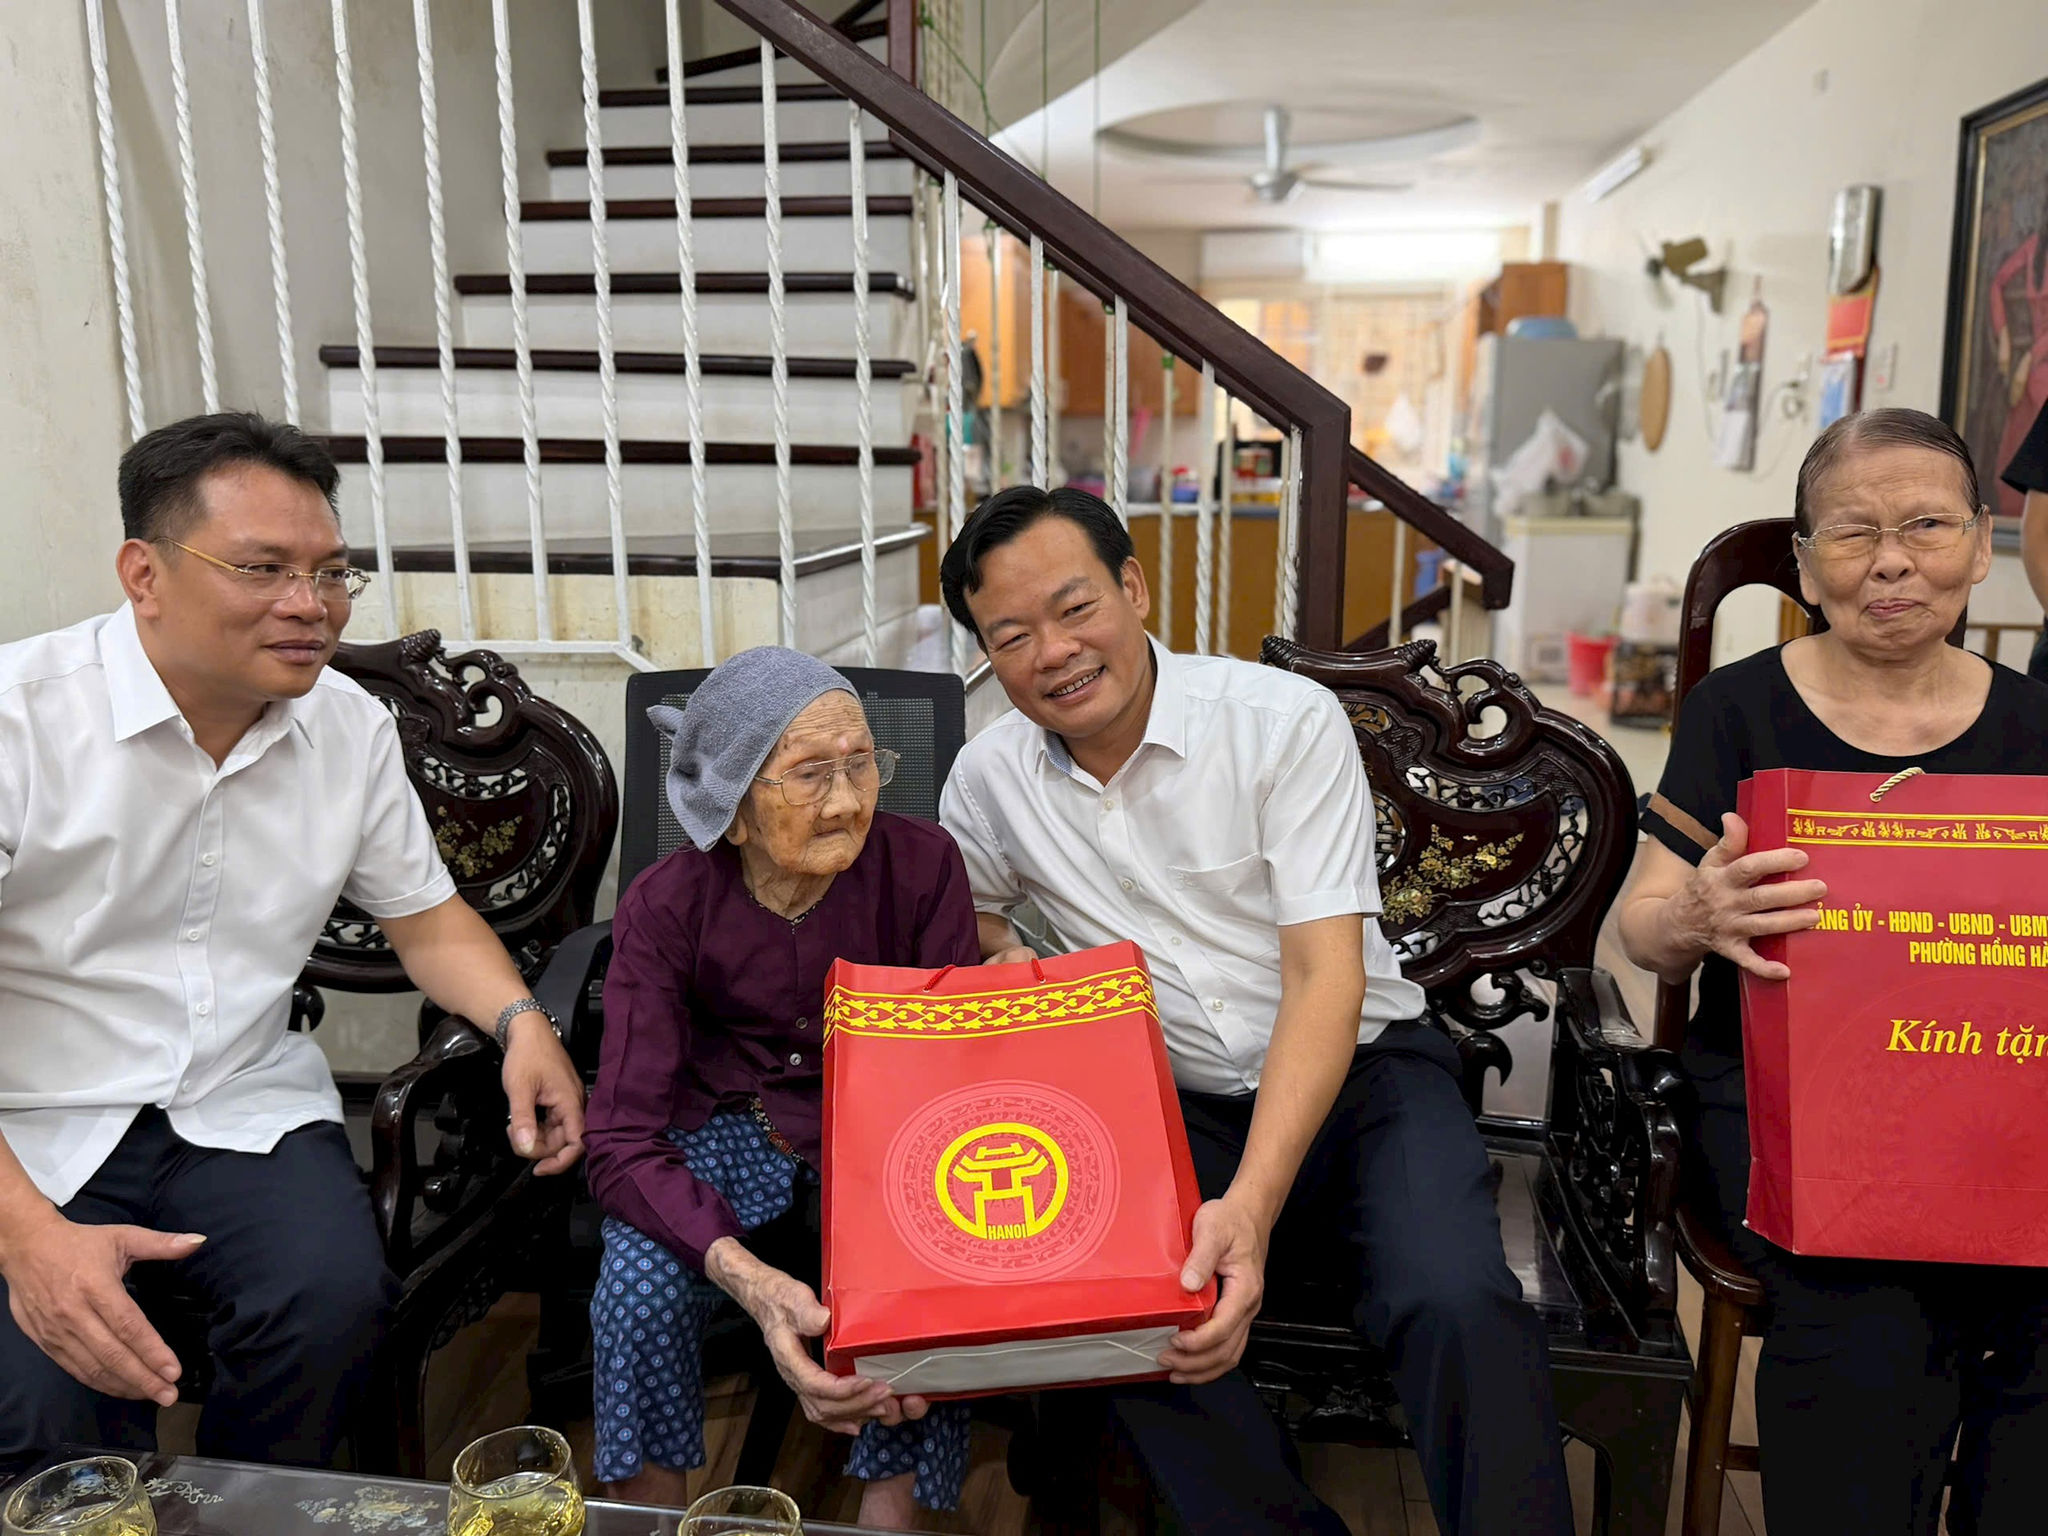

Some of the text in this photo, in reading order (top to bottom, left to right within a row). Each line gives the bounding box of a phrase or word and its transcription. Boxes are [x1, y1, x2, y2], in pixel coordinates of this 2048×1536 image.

[1808, 901, 1849, 931] ẢNG
[1852, 902, 1873, 932] ỦY
[1888, 910, 1934, 934] HĐND
[1948, 912, 1994, 936] UBND
[2009, 914, 2048, 937] UBM
[1909, 936, 1976, 965] PHƯỜNG
[1980, 936, 2026, 967] HỒNG
[1885, 1019, 1983, 1055] Kính
[986, 1223, 1028, 1241] HANOI
